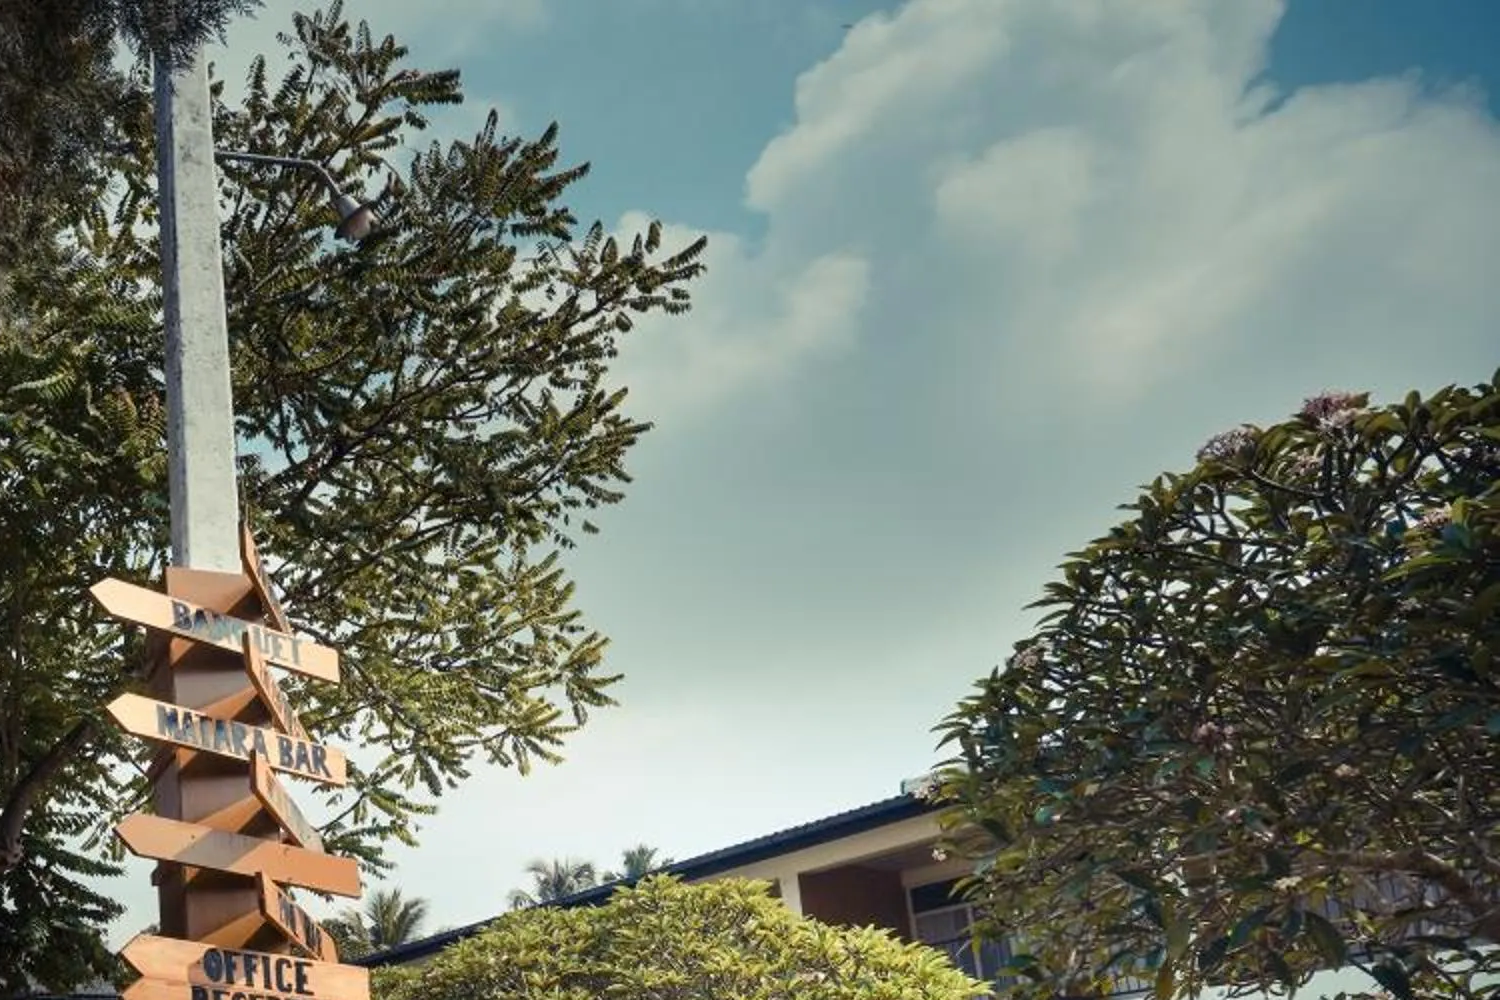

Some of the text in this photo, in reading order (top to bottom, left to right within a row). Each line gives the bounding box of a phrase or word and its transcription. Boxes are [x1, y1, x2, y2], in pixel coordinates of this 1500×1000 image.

[156, 703, 333, 779] MATARA BAR
[203, 948, 314, 996] OFFICE
